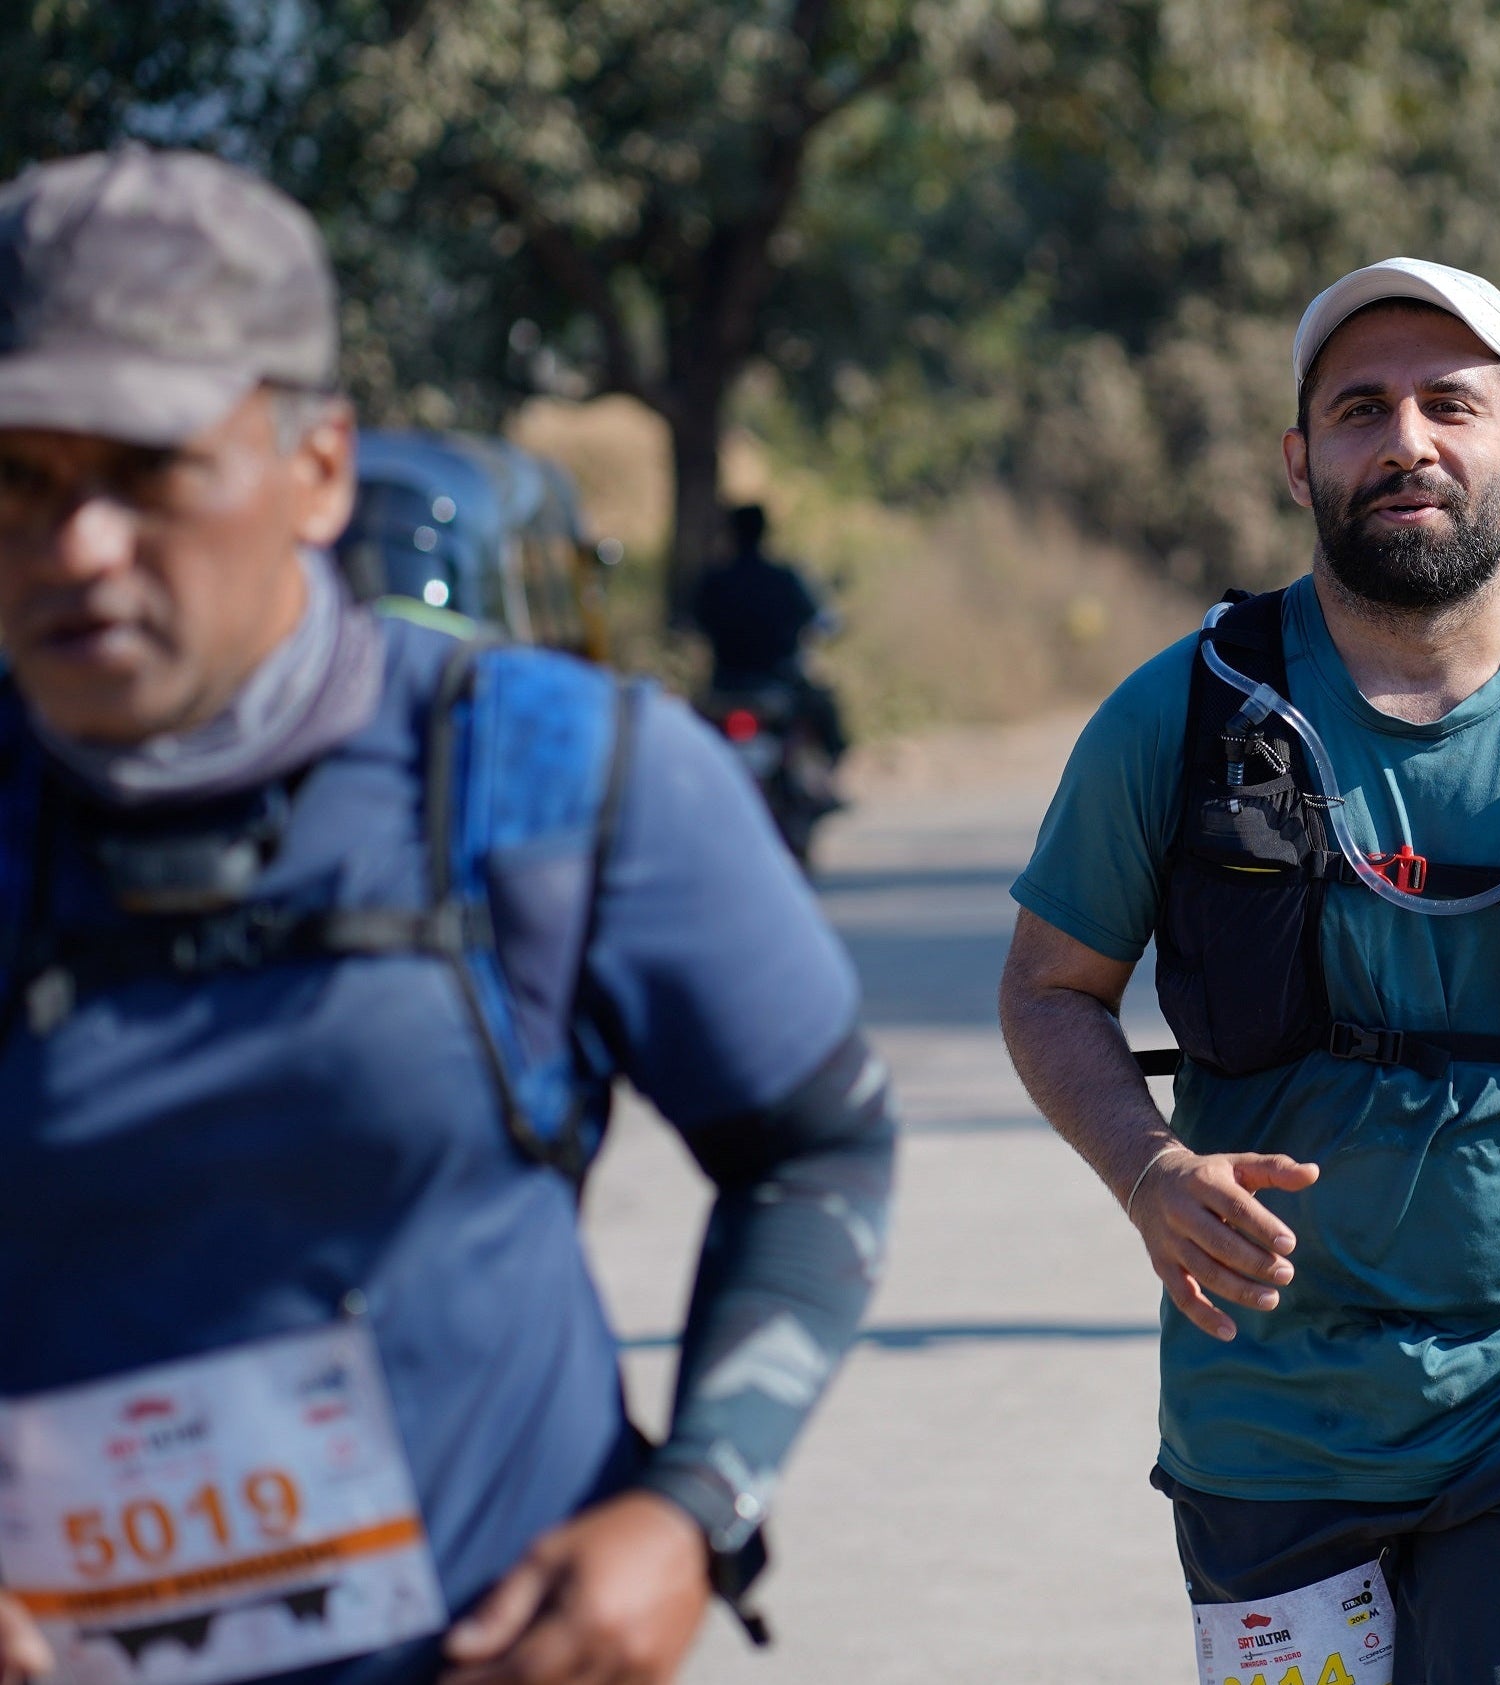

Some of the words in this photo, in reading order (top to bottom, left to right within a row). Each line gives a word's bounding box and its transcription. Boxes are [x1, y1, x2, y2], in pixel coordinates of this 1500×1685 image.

[63, 1467, 302, 1579] 5019
[1350, 1613, 1367, 1625] 20K
[1237, 1636, 1255, 1650] SRT
[1255, 1629, 1292, 1647] ULTRA
[1273, 1651, 1302, 1663] RAJGAD
